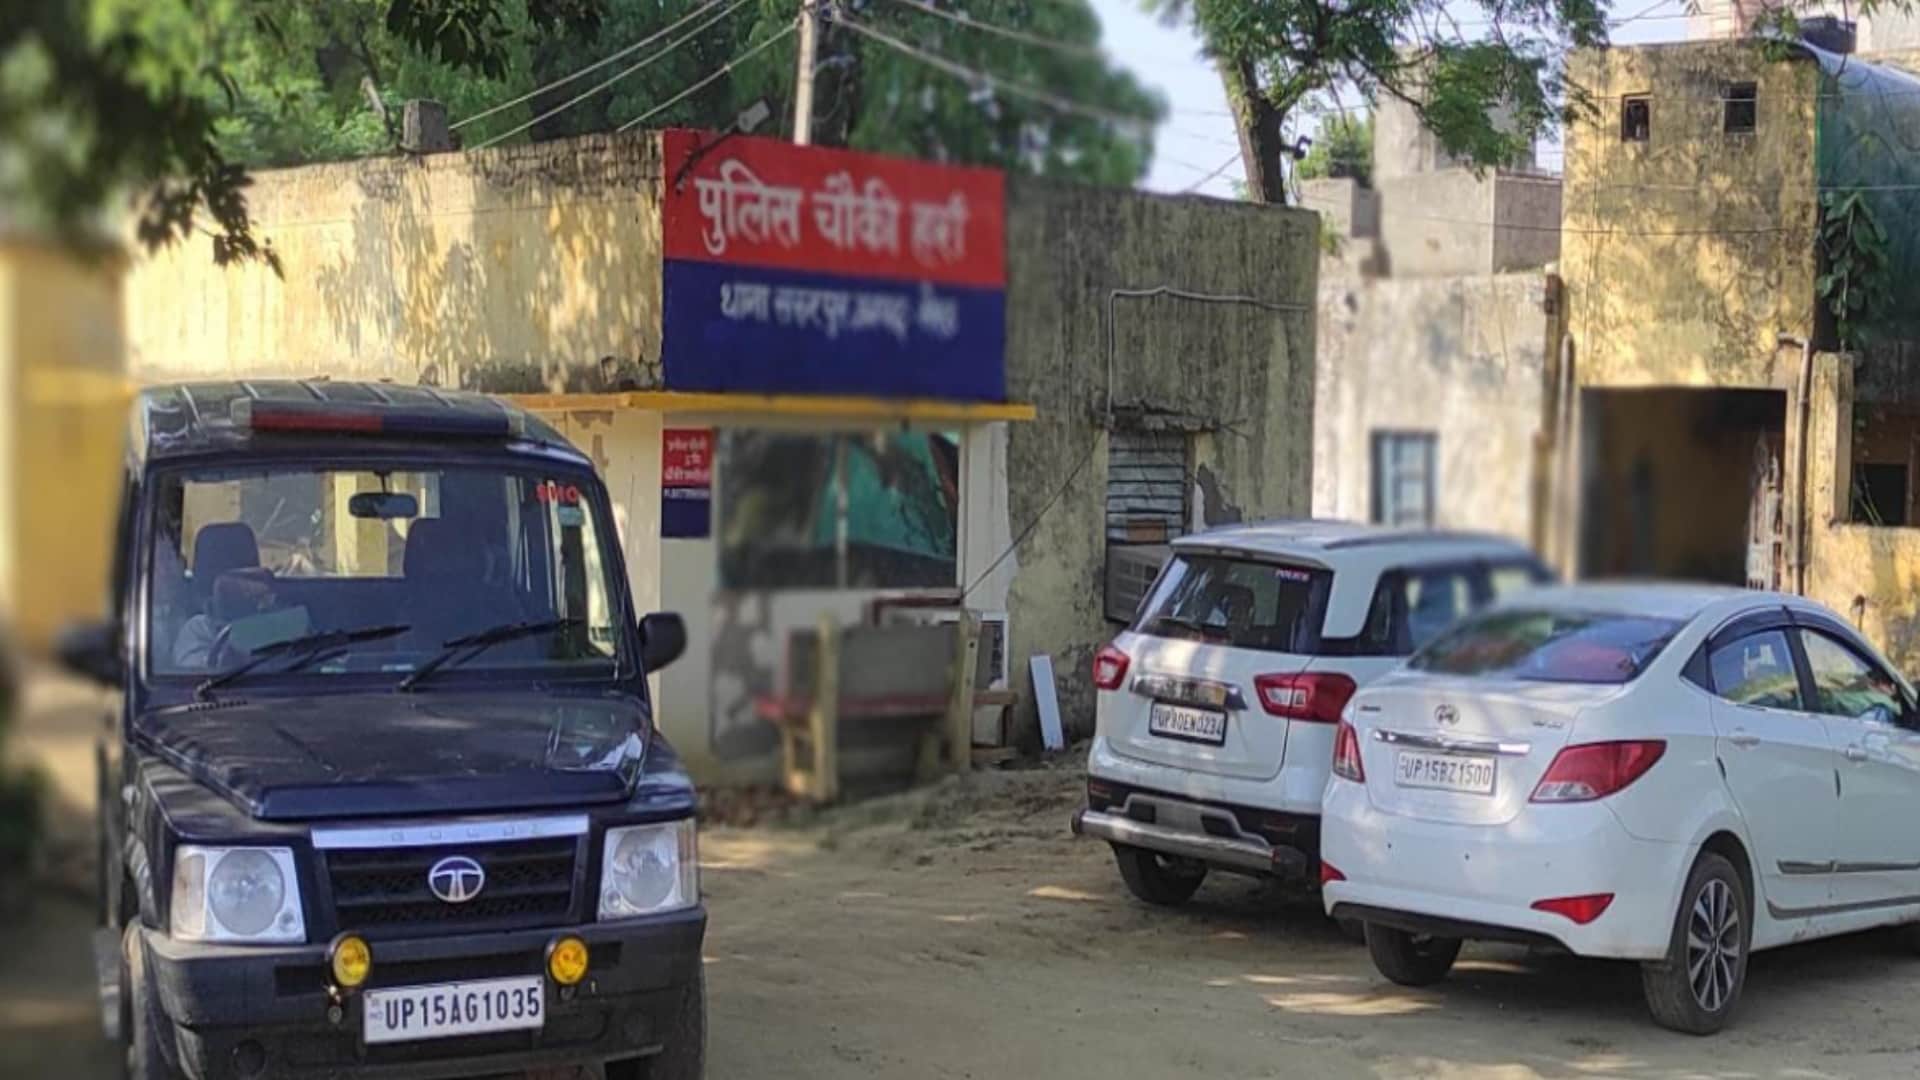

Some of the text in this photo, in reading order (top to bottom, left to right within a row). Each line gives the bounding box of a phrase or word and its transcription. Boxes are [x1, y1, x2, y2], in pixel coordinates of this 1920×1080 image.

[696, 160, 802, 256] पुलिस
[812, 172, 899, 257] चौकी
[720, 283, 770, 322] थाना
[385, 987, 541, 1030] UP15AG1035
